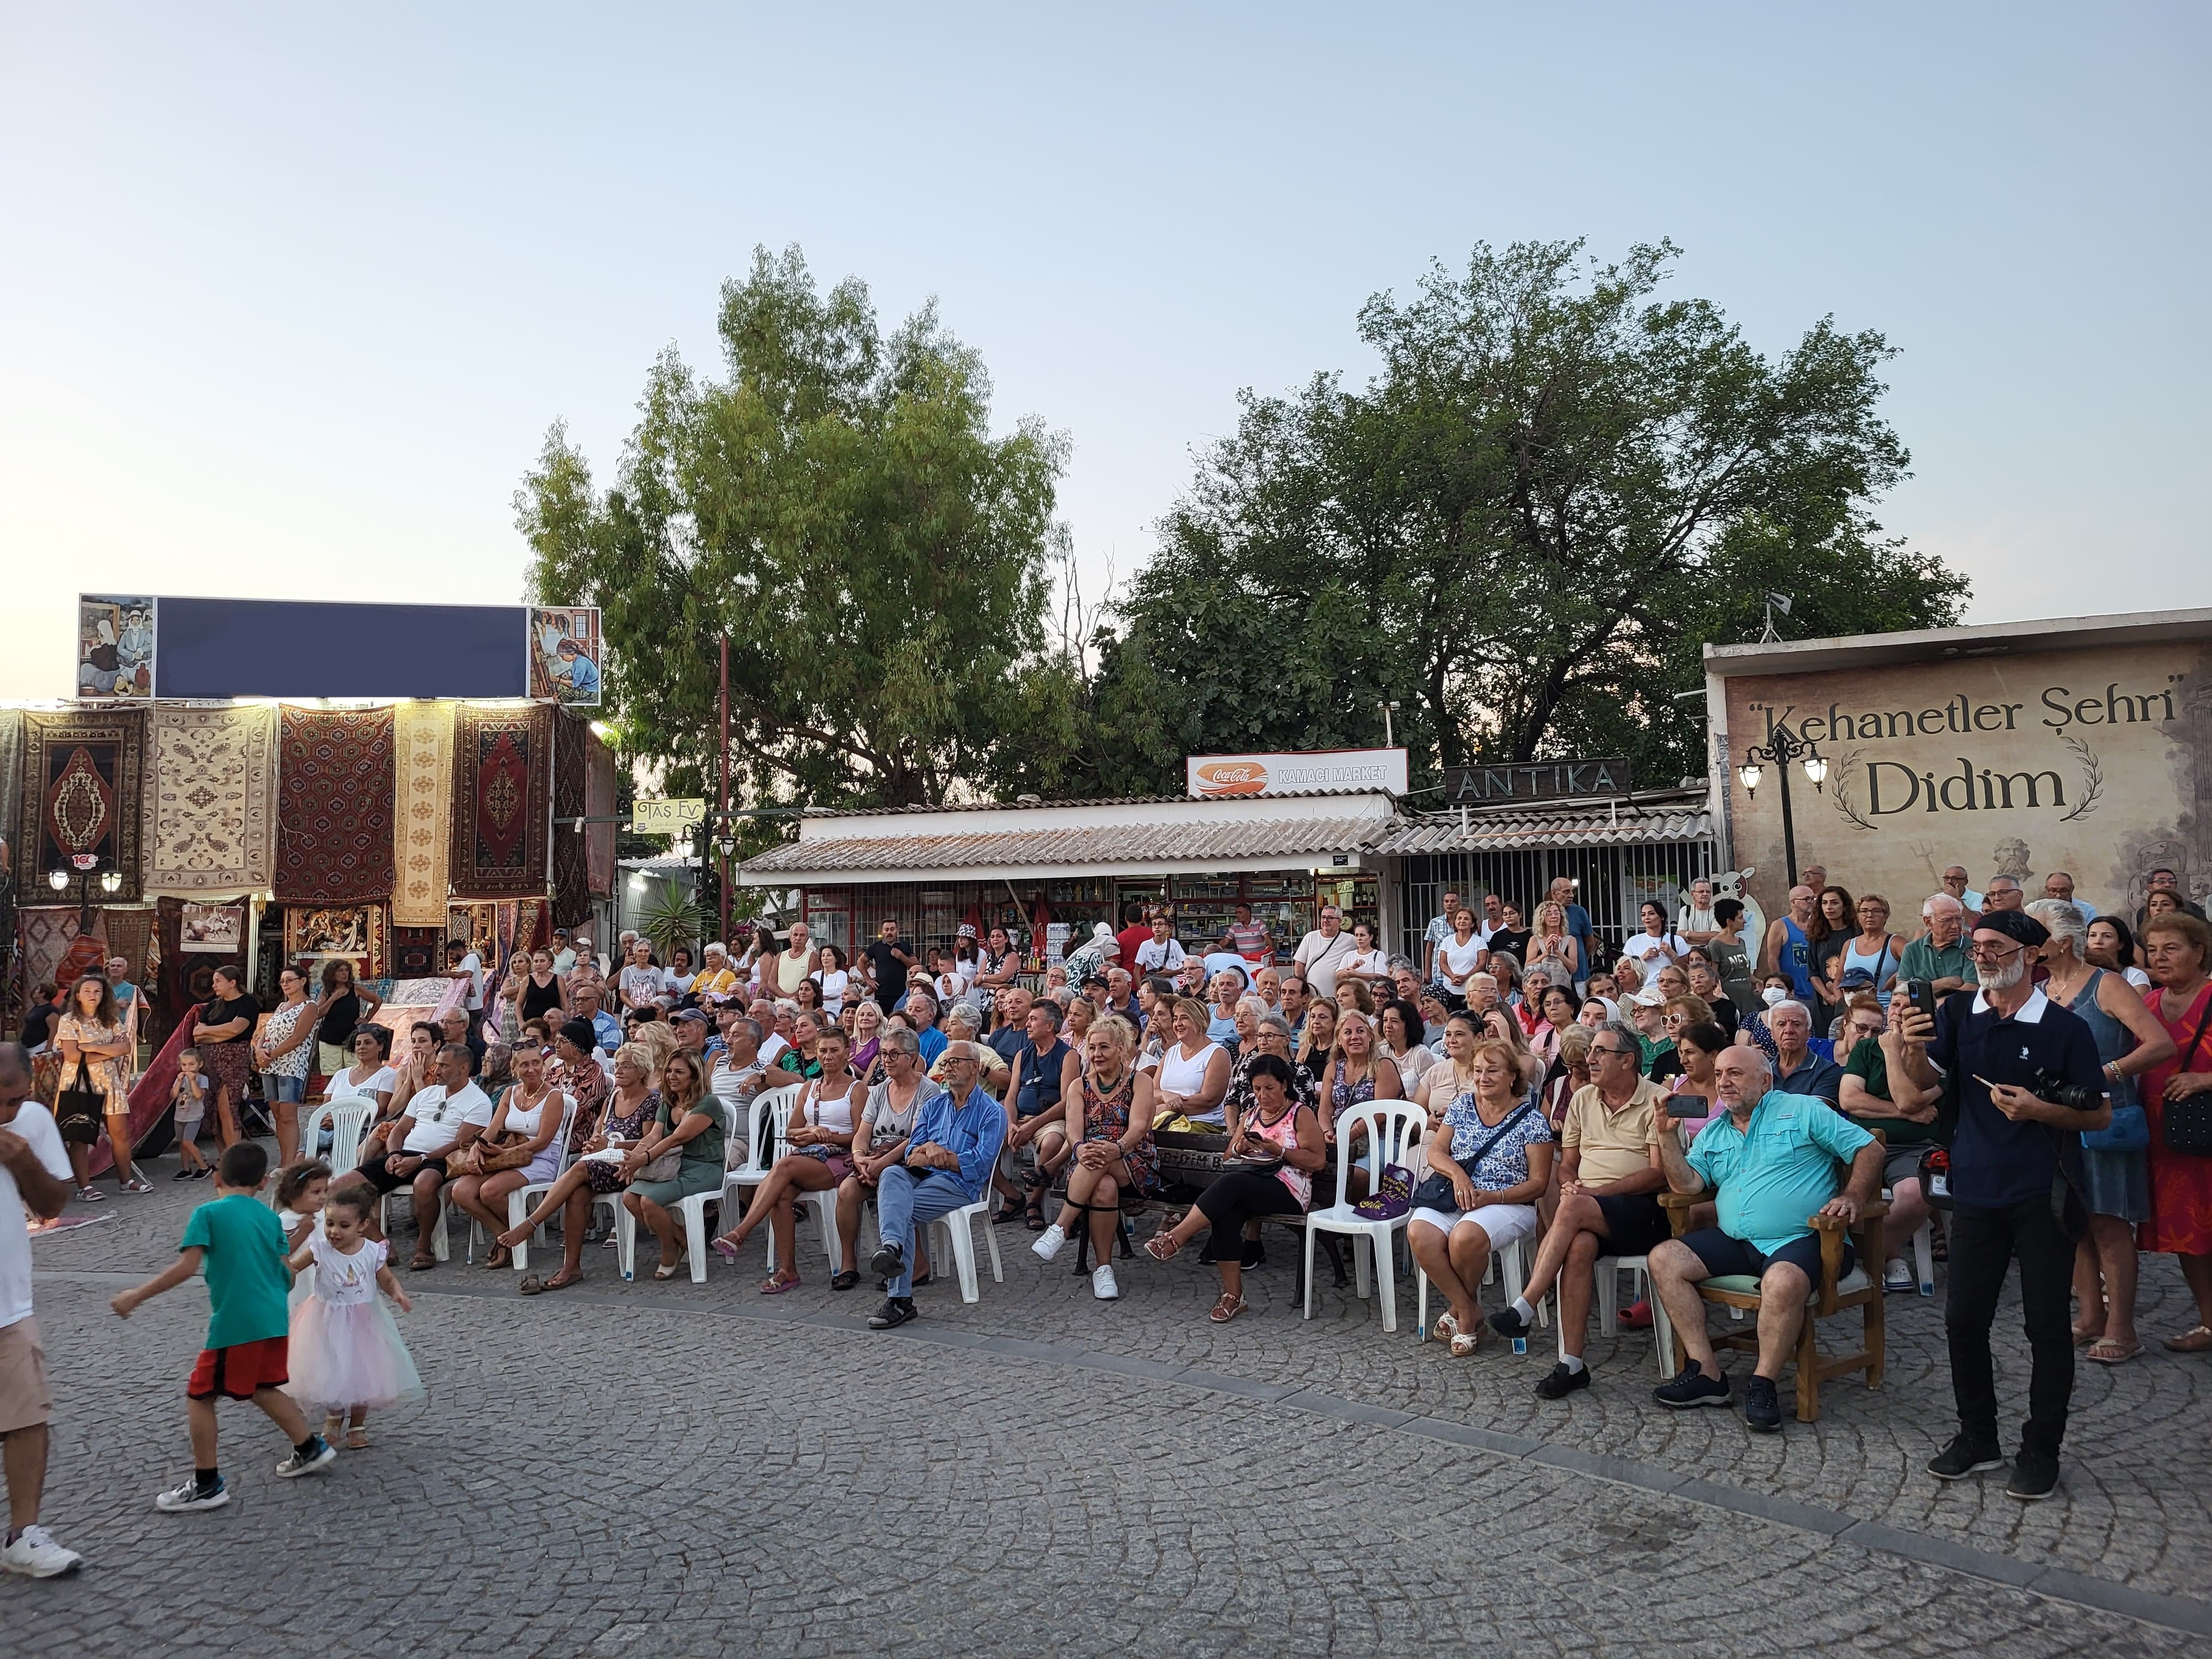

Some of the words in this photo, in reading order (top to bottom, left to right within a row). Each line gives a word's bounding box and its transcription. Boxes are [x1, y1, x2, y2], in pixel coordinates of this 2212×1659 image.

[1212, 767, 1251, 782] Coca-Cola
[1279, 768, 1329, 784] KAMACI
[1333, 765, 1387, 781] MARKET
[1457, 764, 1618, 799] ANTIKA
[1866, 757, 2067, 815] Didim
